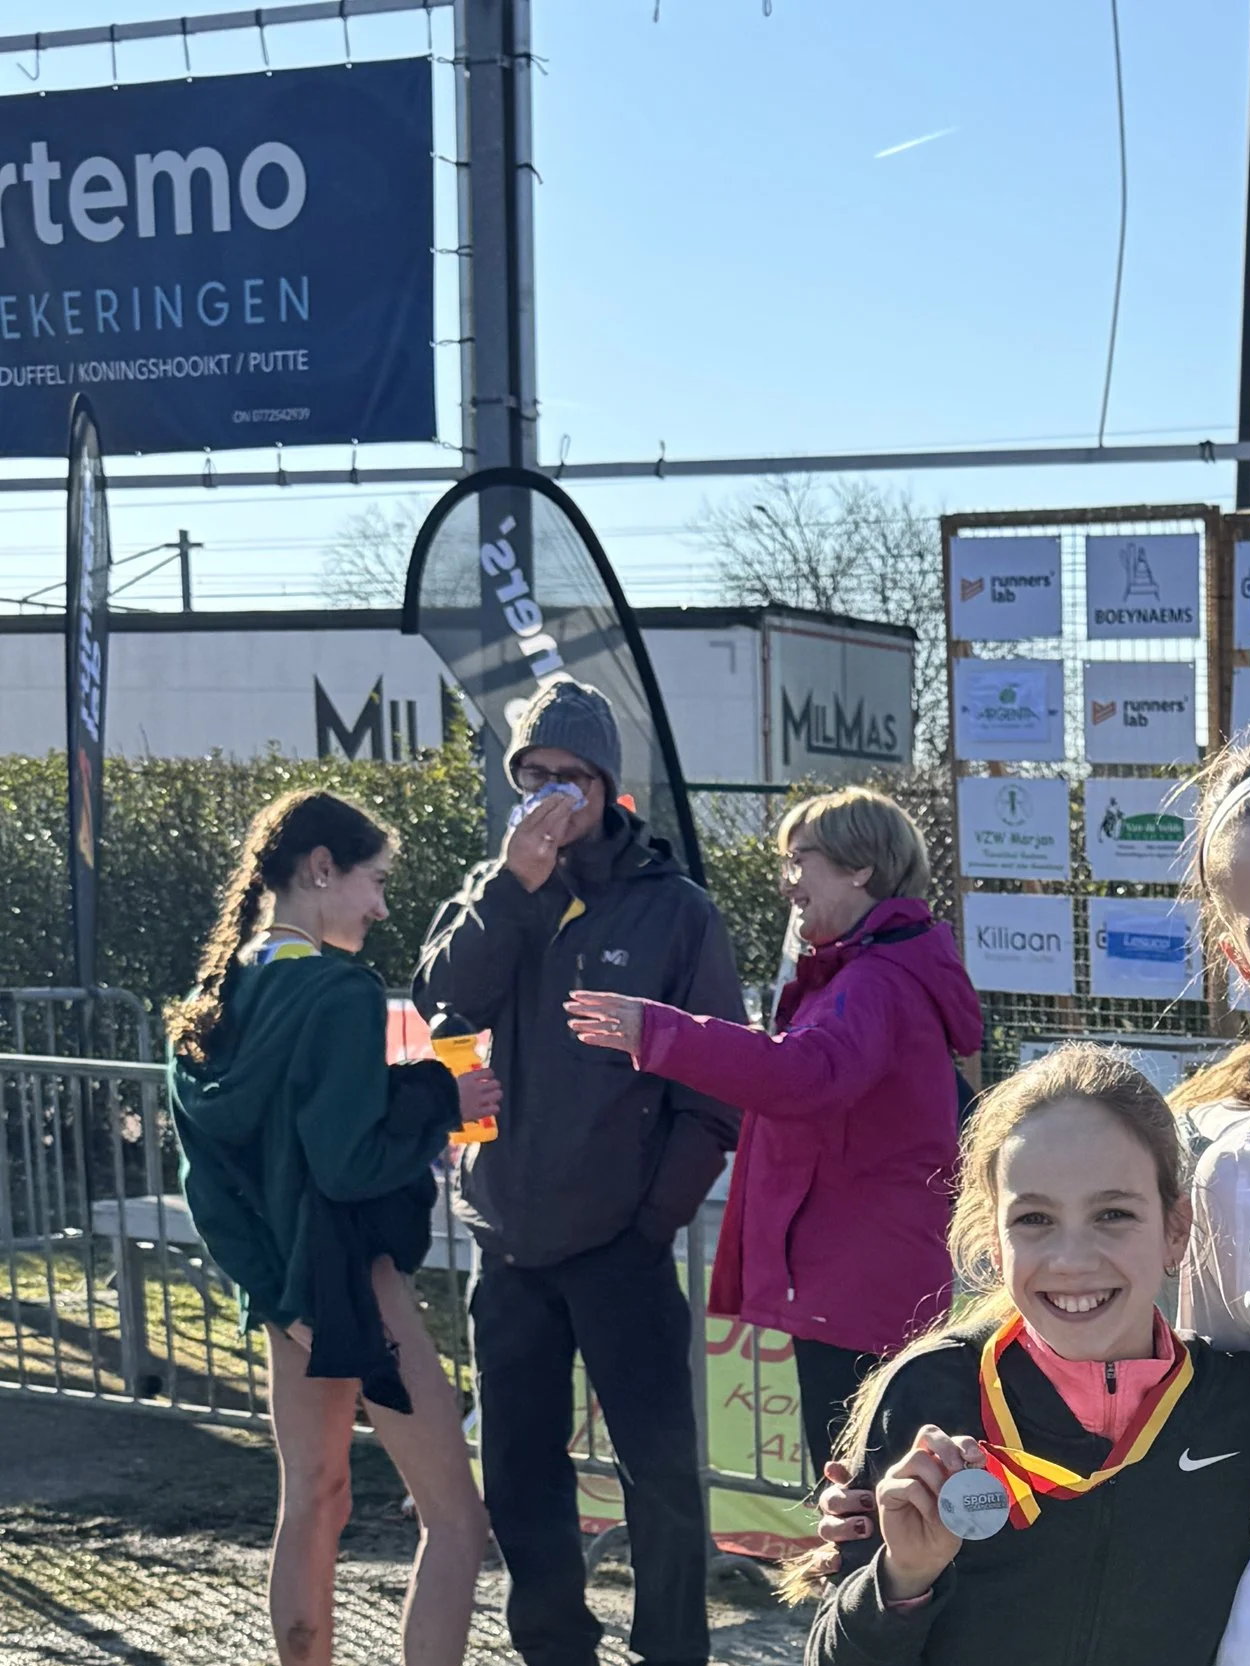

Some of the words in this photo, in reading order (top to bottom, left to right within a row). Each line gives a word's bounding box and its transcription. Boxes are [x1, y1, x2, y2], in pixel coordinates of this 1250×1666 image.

[0, 276, 309, 339] EKERINGEN
[0, 365, 65, 387] DUFFEL
[78, 354, 231, 382] KONINGSHOOIKT
[250, 350, 309, 372] PUTTE
[991, 589, 1016, 604] lab
[1094, 607, 1193, 625] BOEYNAEMS
[314, 674, 467, 763] MIL
[1123, 713, 1148, 727] lab
[977, 926, 1061, 952] Kiliaan
